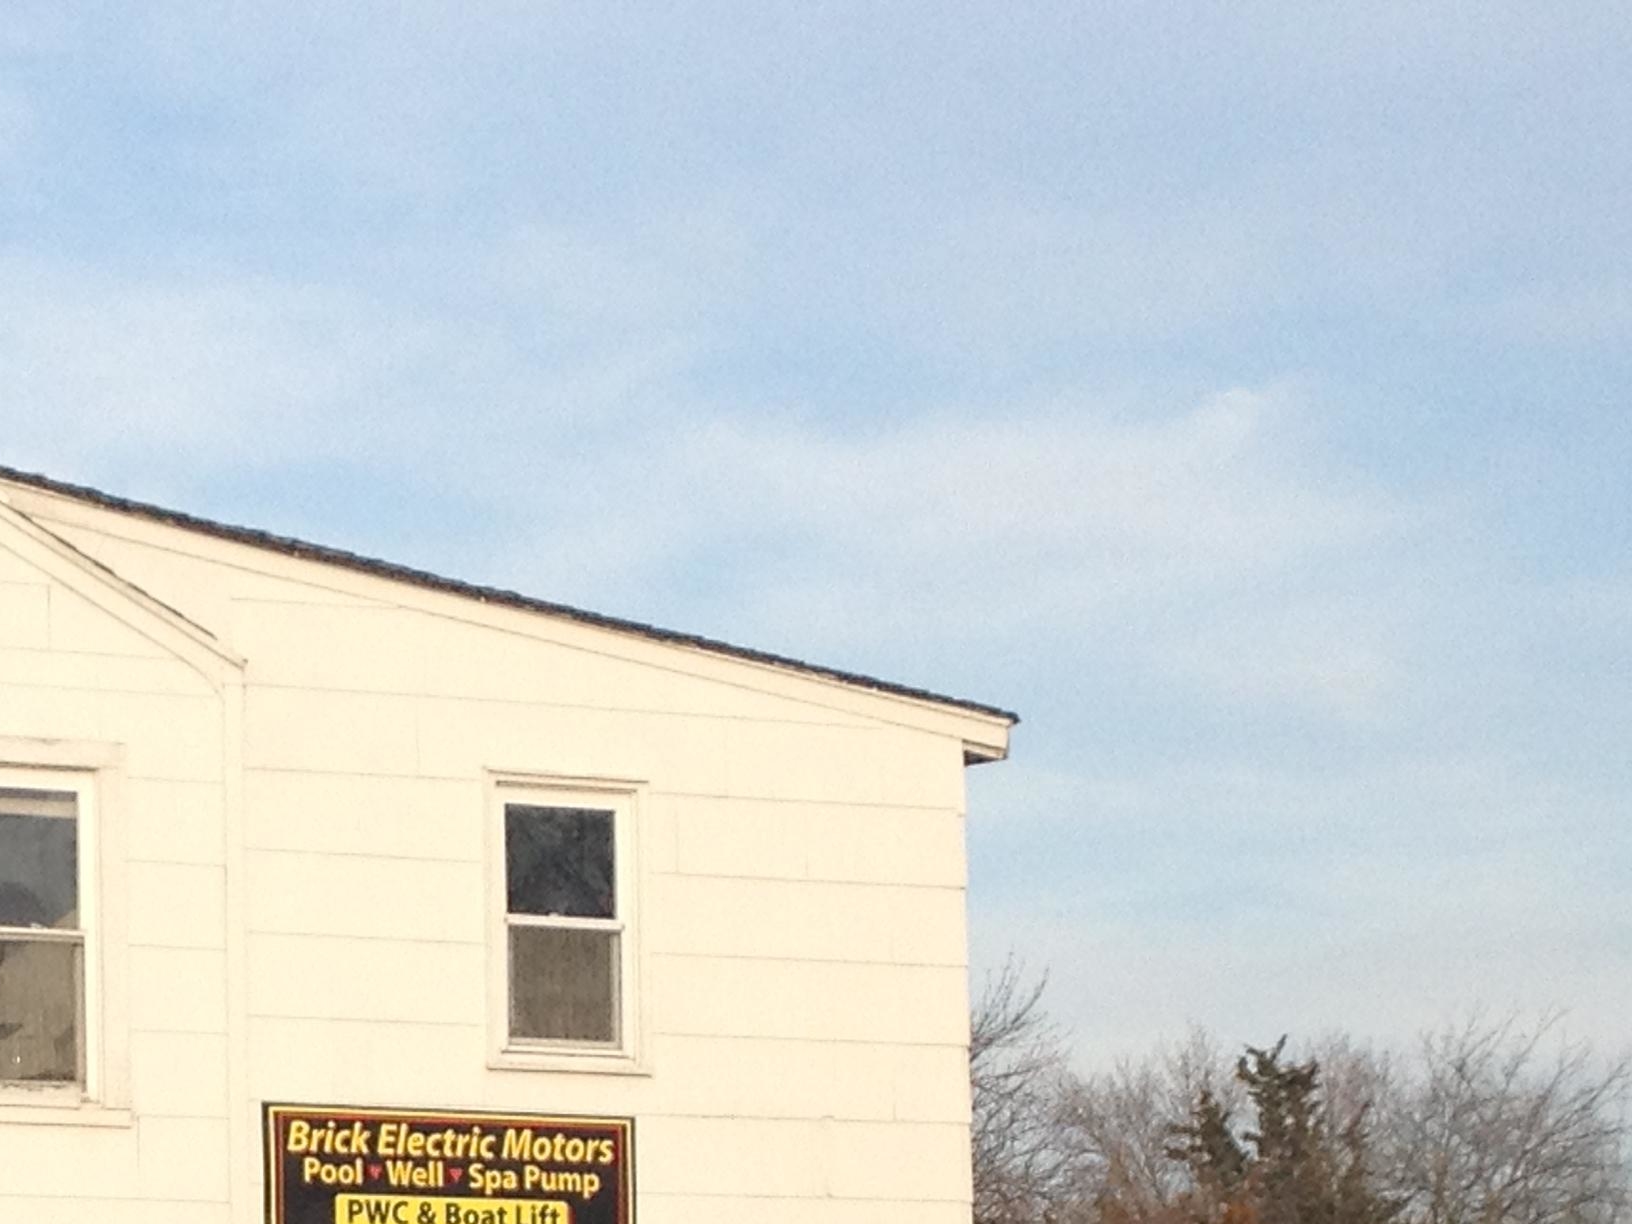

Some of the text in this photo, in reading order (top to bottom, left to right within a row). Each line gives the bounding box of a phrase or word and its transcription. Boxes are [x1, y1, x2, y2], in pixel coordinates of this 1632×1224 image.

[287, 1120, 614, 1164] Brick Electric Motors
[303, 1159, 600, 1199] Pool Well Spa Pump
[347, 1199, 409, 1224] PWC
